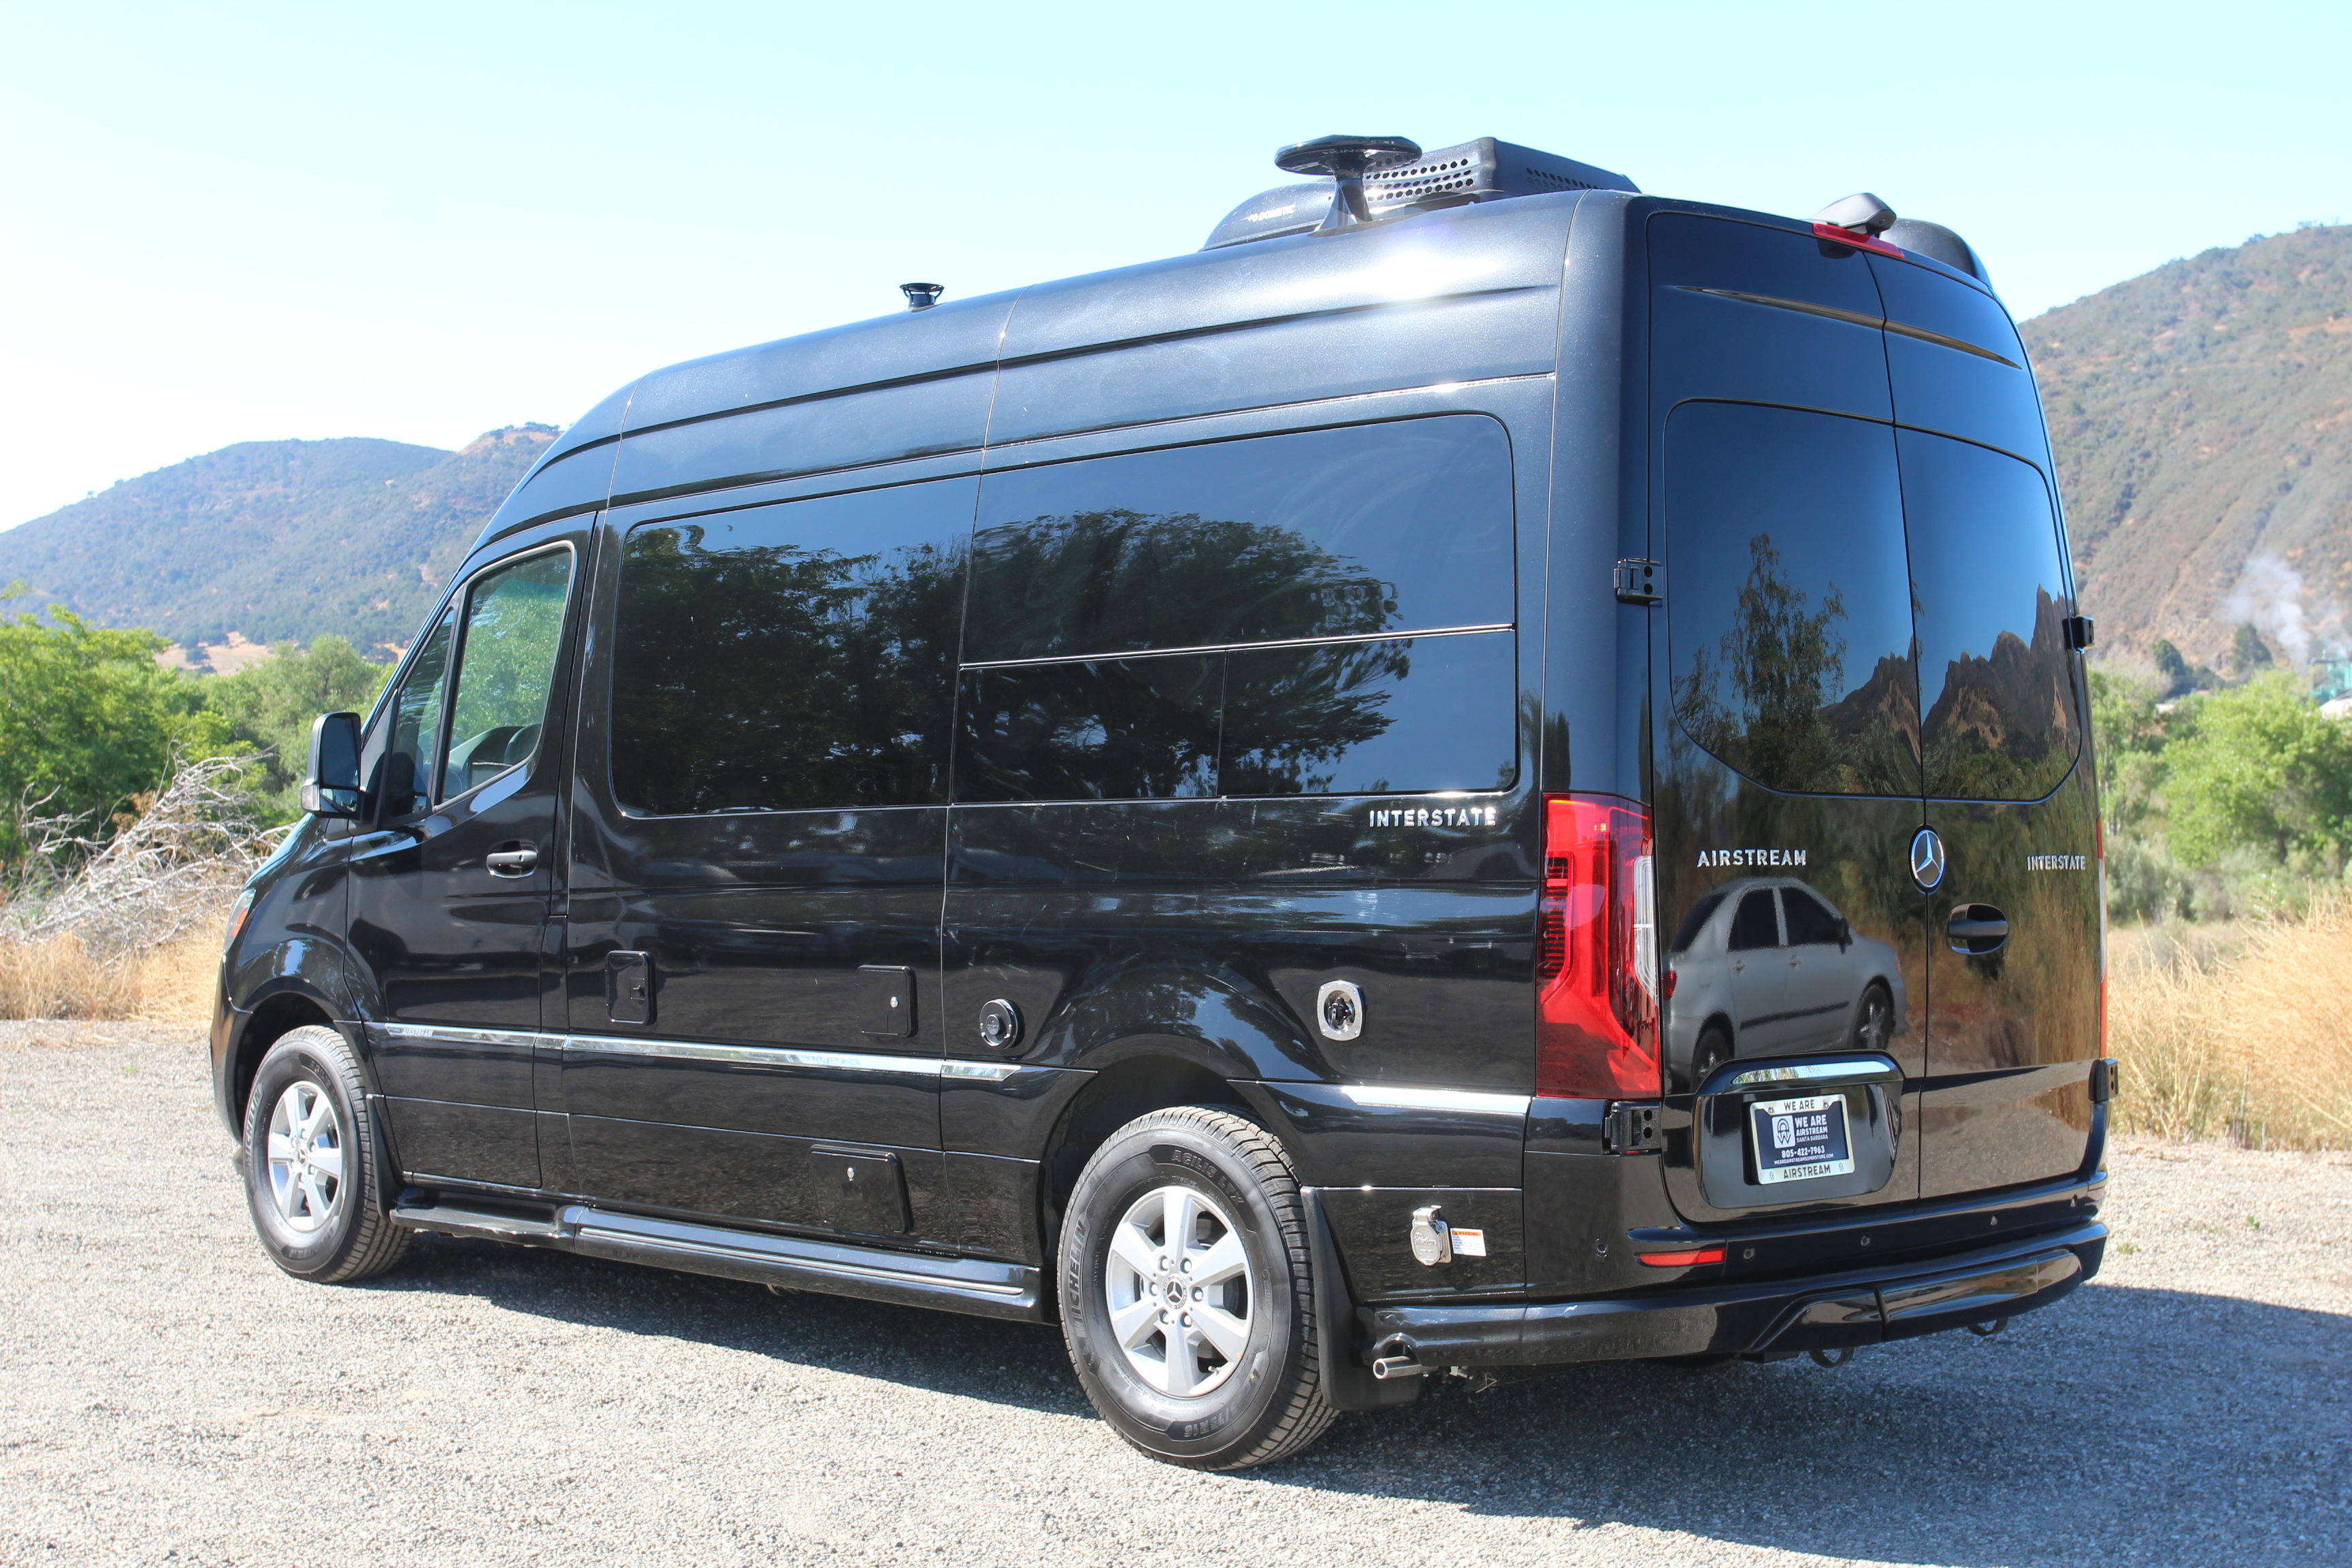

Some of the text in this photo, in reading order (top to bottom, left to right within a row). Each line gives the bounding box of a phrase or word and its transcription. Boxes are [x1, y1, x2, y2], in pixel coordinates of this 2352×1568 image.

[1369, 807, 1497, 828] INTERSTATE
[1697, 849, 1807, 868] AIRSTREAM
[2027, 855, 2085, 870] INTERSTATE
[402, 1028, 434, 1037] AIRSTREAM
[1784, 1099, 1815, 1111] WE ARE
[245, 1088, 261, 1168] MICHELIN
[1795, 1114, 1827, 1128] WE ARE
[1796, 1126, 1828, 1137] AIRSTREAM
[1781, 1145, 1825, 1158] 805-422-7963
[1171, 1149, 1218, 1177] AGILIS
[1218, 1176, 1244, 1206] LTX
[1784, 1164, 1831, 1179] AIRSTREAM
[1069, 1219, 1087, 1338] MICHELIN
